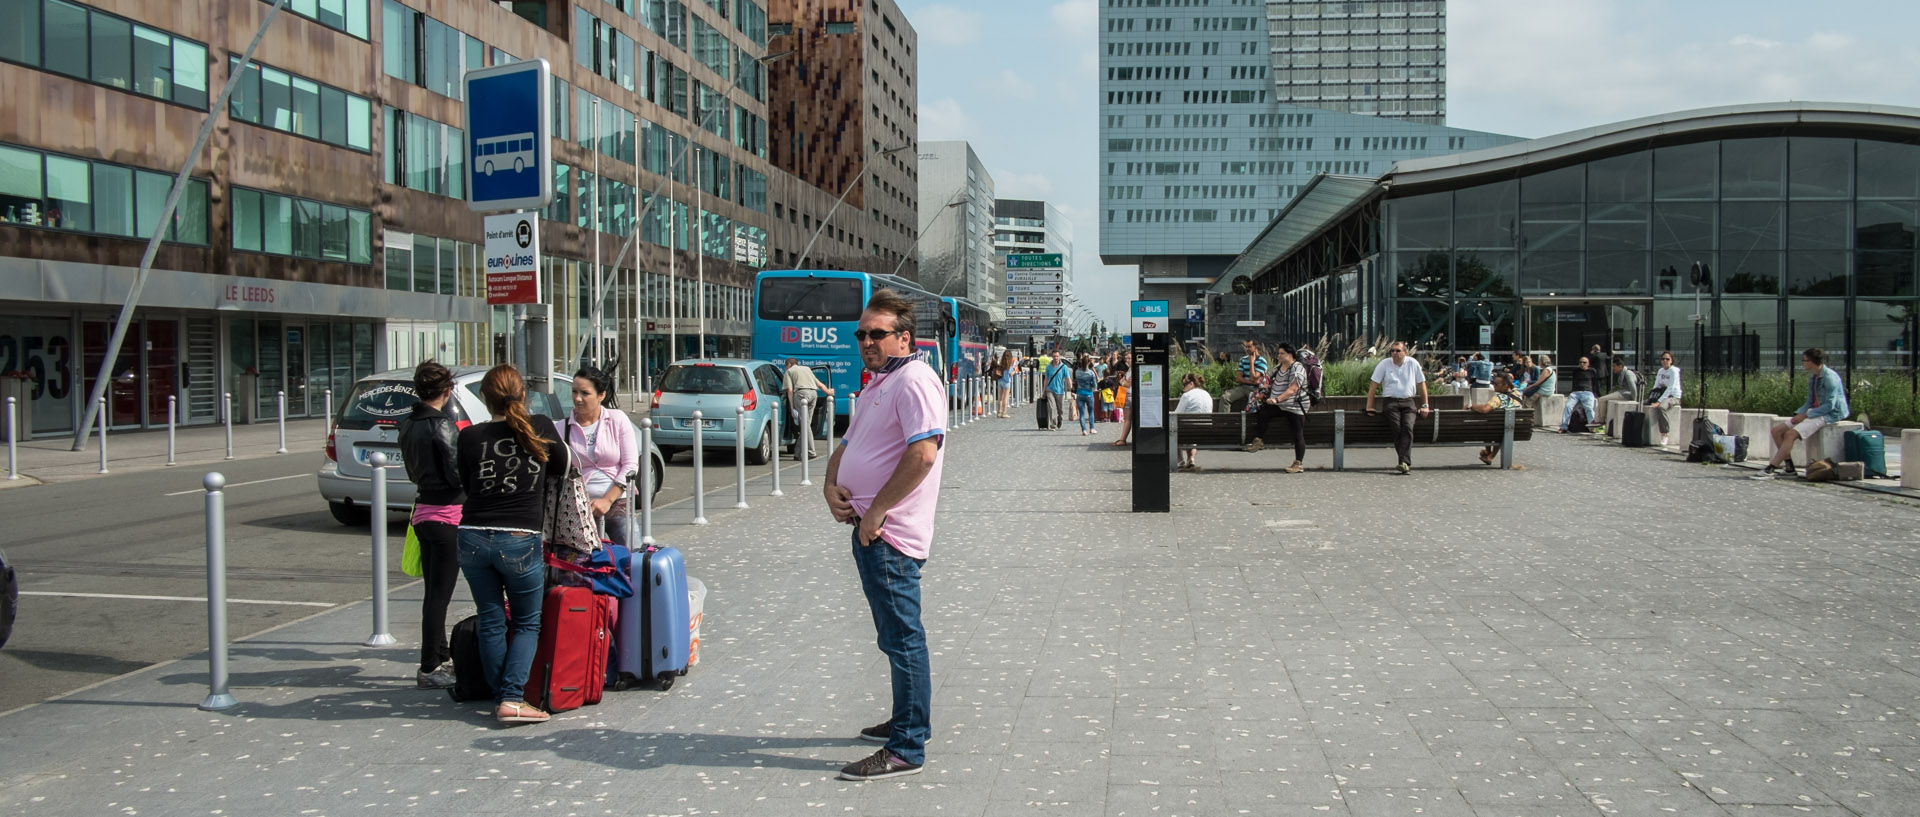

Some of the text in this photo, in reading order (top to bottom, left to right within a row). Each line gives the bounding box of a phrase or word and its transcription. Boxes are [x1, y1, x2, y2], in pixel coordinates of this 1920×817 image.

[486, 231, 498, 239] Point
[225, 285, 275, 304] LE LEEDS
[1188, 310, 1196, 319] P
[359, 385, 412, 400] MERCEDES-BENZ
